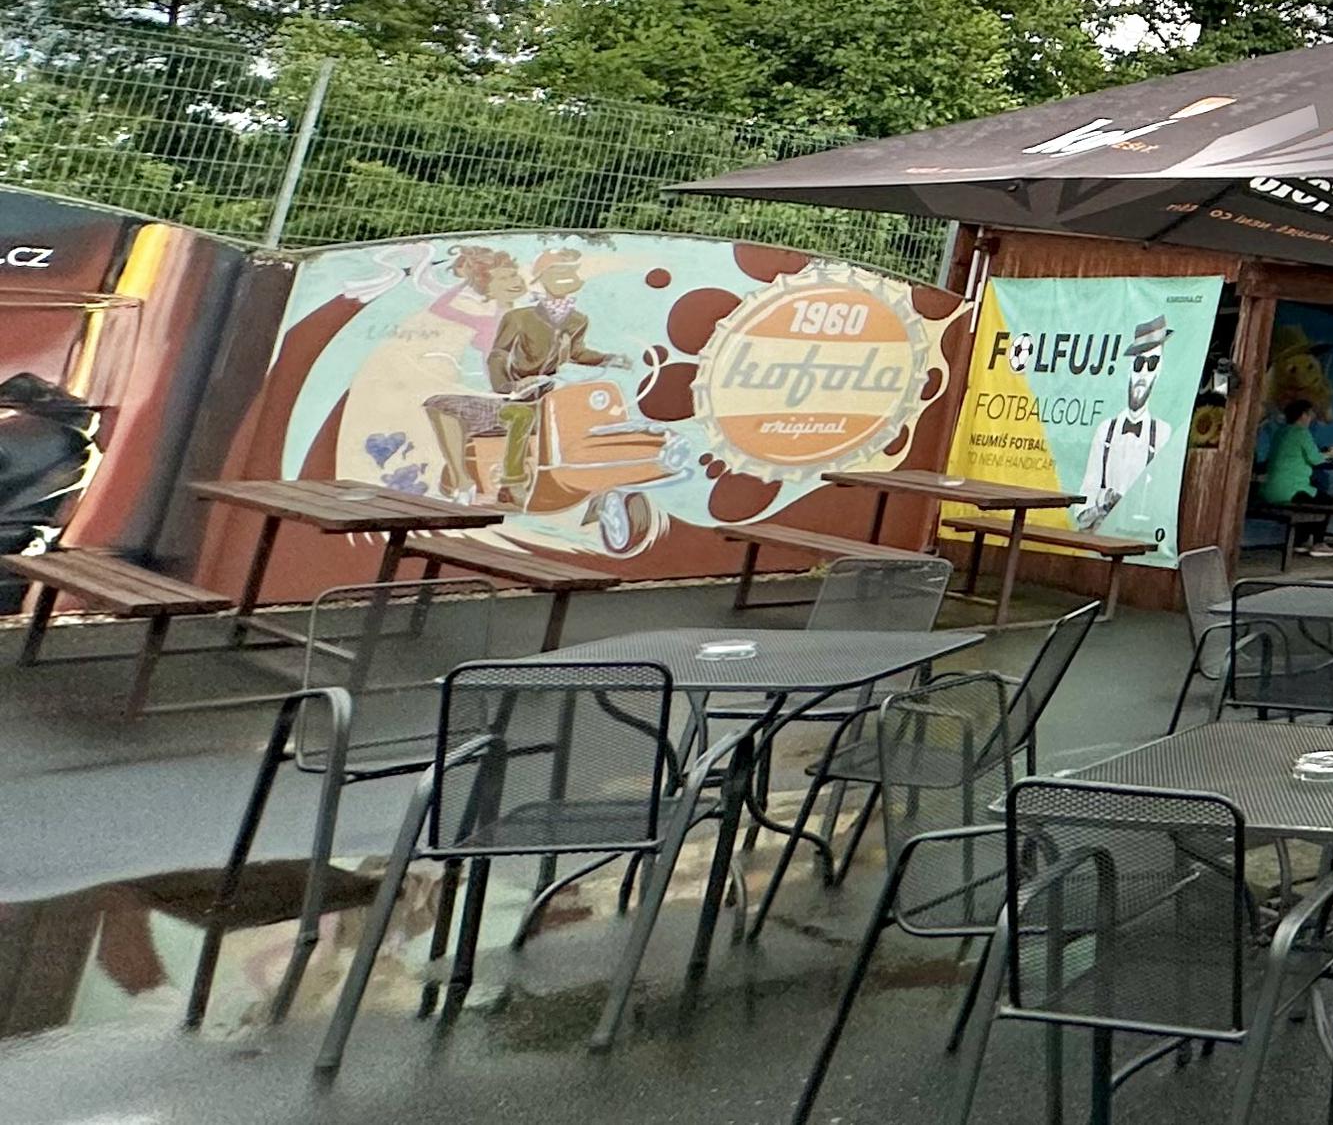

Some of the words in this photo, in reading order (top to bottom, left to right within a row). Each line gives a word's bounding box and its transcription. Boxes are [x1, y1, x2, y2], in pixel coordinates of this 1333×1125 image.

[790, 300, 869, 336] 1960
[721, 342, 903, 407] kofola
[974, 392, 1104, 426] FOTBALGOLF
[760, 417, 846, 440] original
